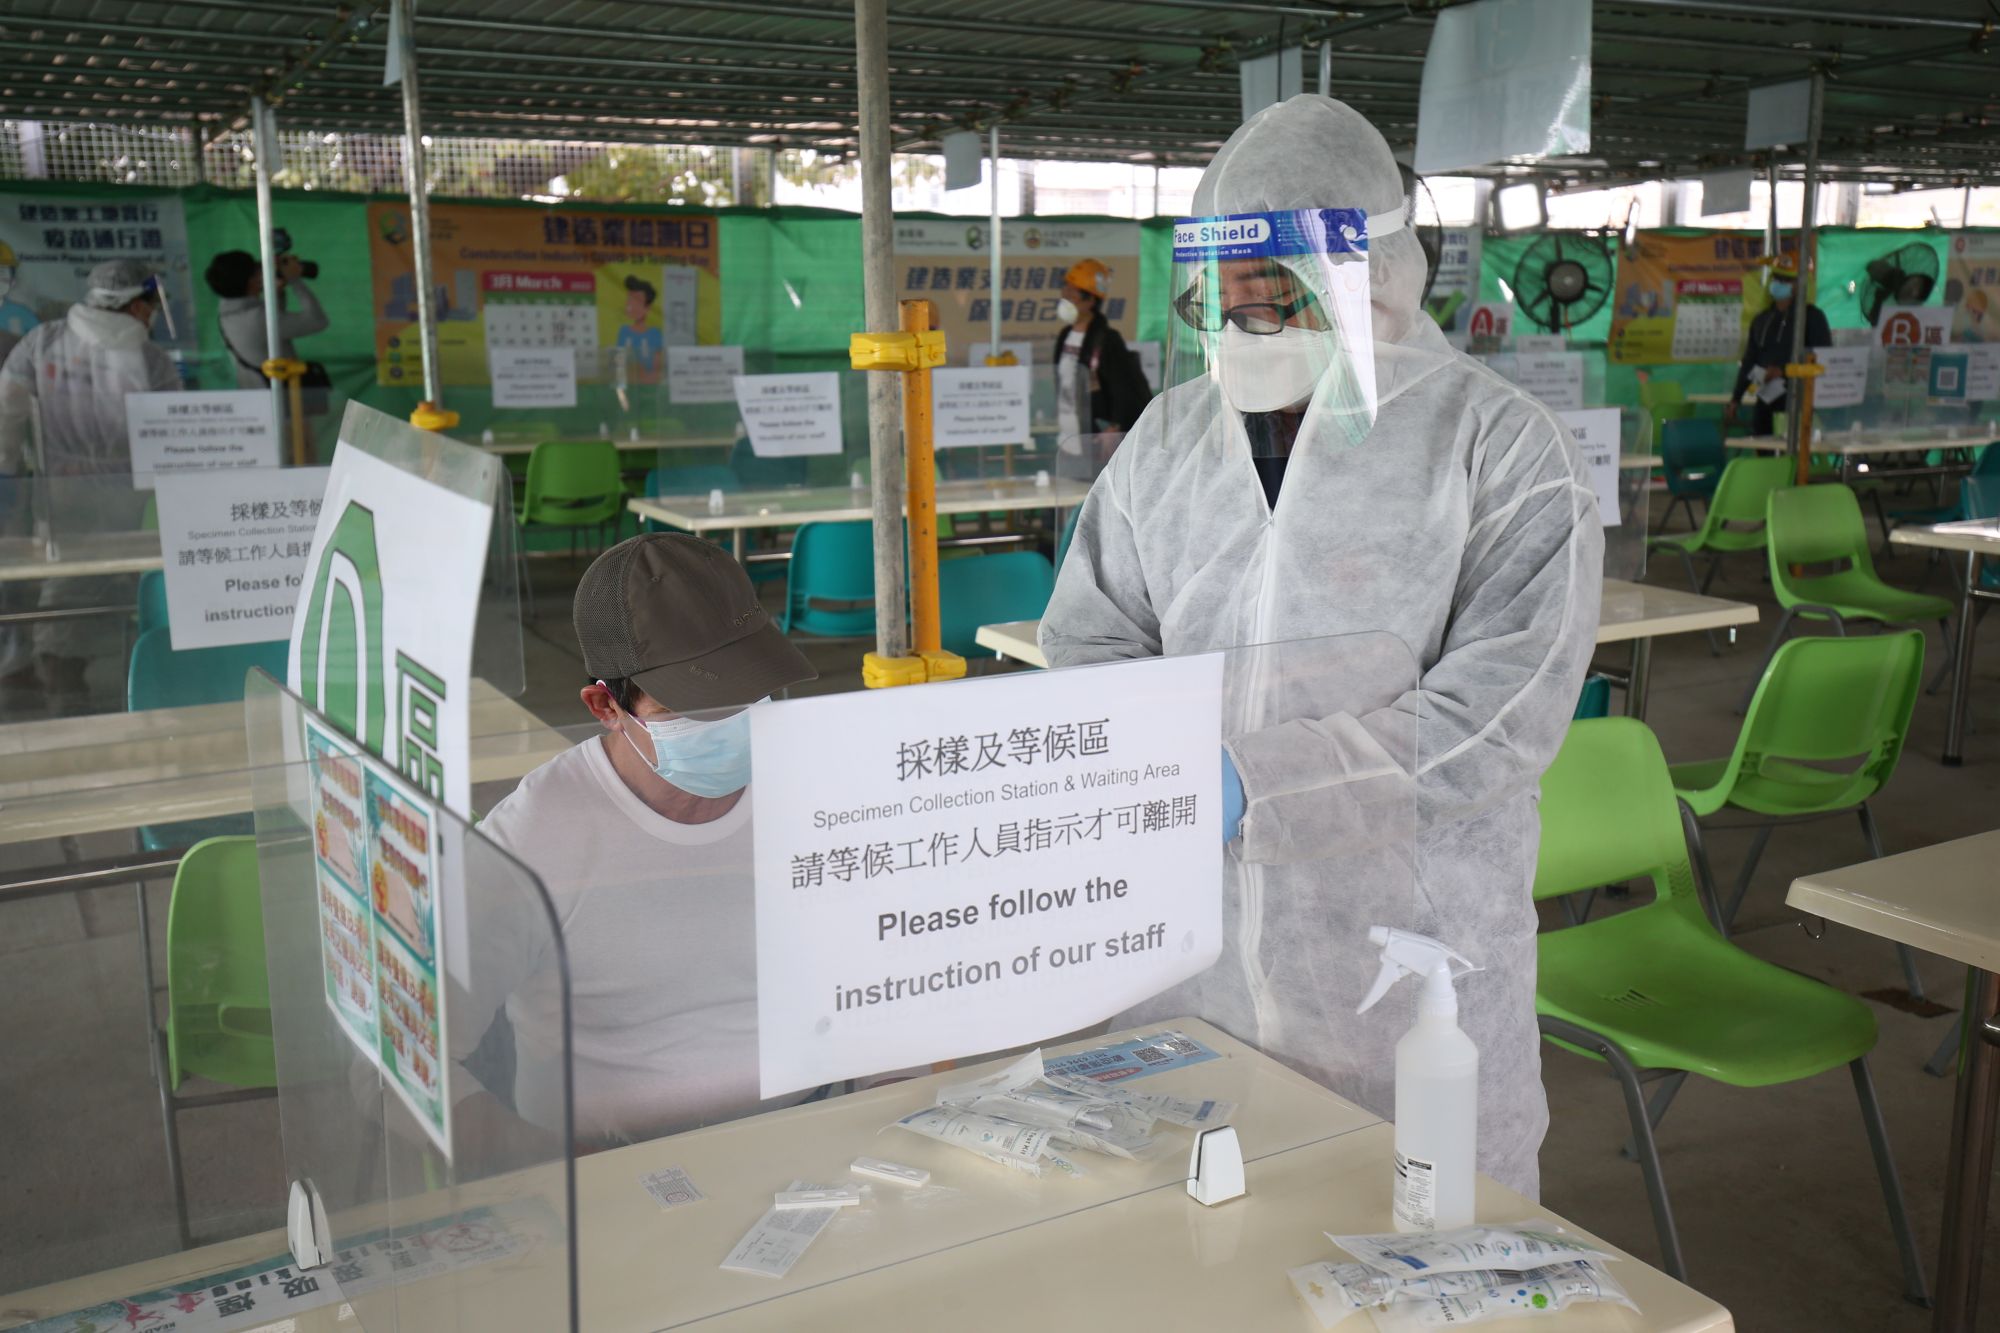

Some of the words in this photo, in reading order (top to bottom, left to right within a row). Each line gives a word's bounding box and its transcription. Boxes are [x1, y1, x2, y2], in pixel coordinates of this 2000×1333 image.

[1200, 223, 1259, 242] Shield
[188, 529, 236, 541] Specimen
[238, 526, 285, 537] Collection
[204, 604, 295, 623] instruction
[225, 576, 280, 592] Please
[896, 718, 1110, 782] 採樣及等候區
[813, 800, 903, 830] Specimen
[909, 788, 995, 815] Collection
[1000, 779, 1059, 801] Station
[1064, 774, 1076, 792] &
[1080, 768, 1139, 791] Waiting
[1143, 762, 1181, 780] Area
[791, 793, 1197, 889] 請等候工作人員指示才可離開
[877, 900, 979, 941] Please
[988, 886, 1077, 921] follow
[1085, 874, 1129, 904] the
[834, 960, 1001, 1012] instruction
[1011, 946, 1042, 976] of
[1048, 939, 1097, 968] our
[1104, 922, 1166, 958] staff
